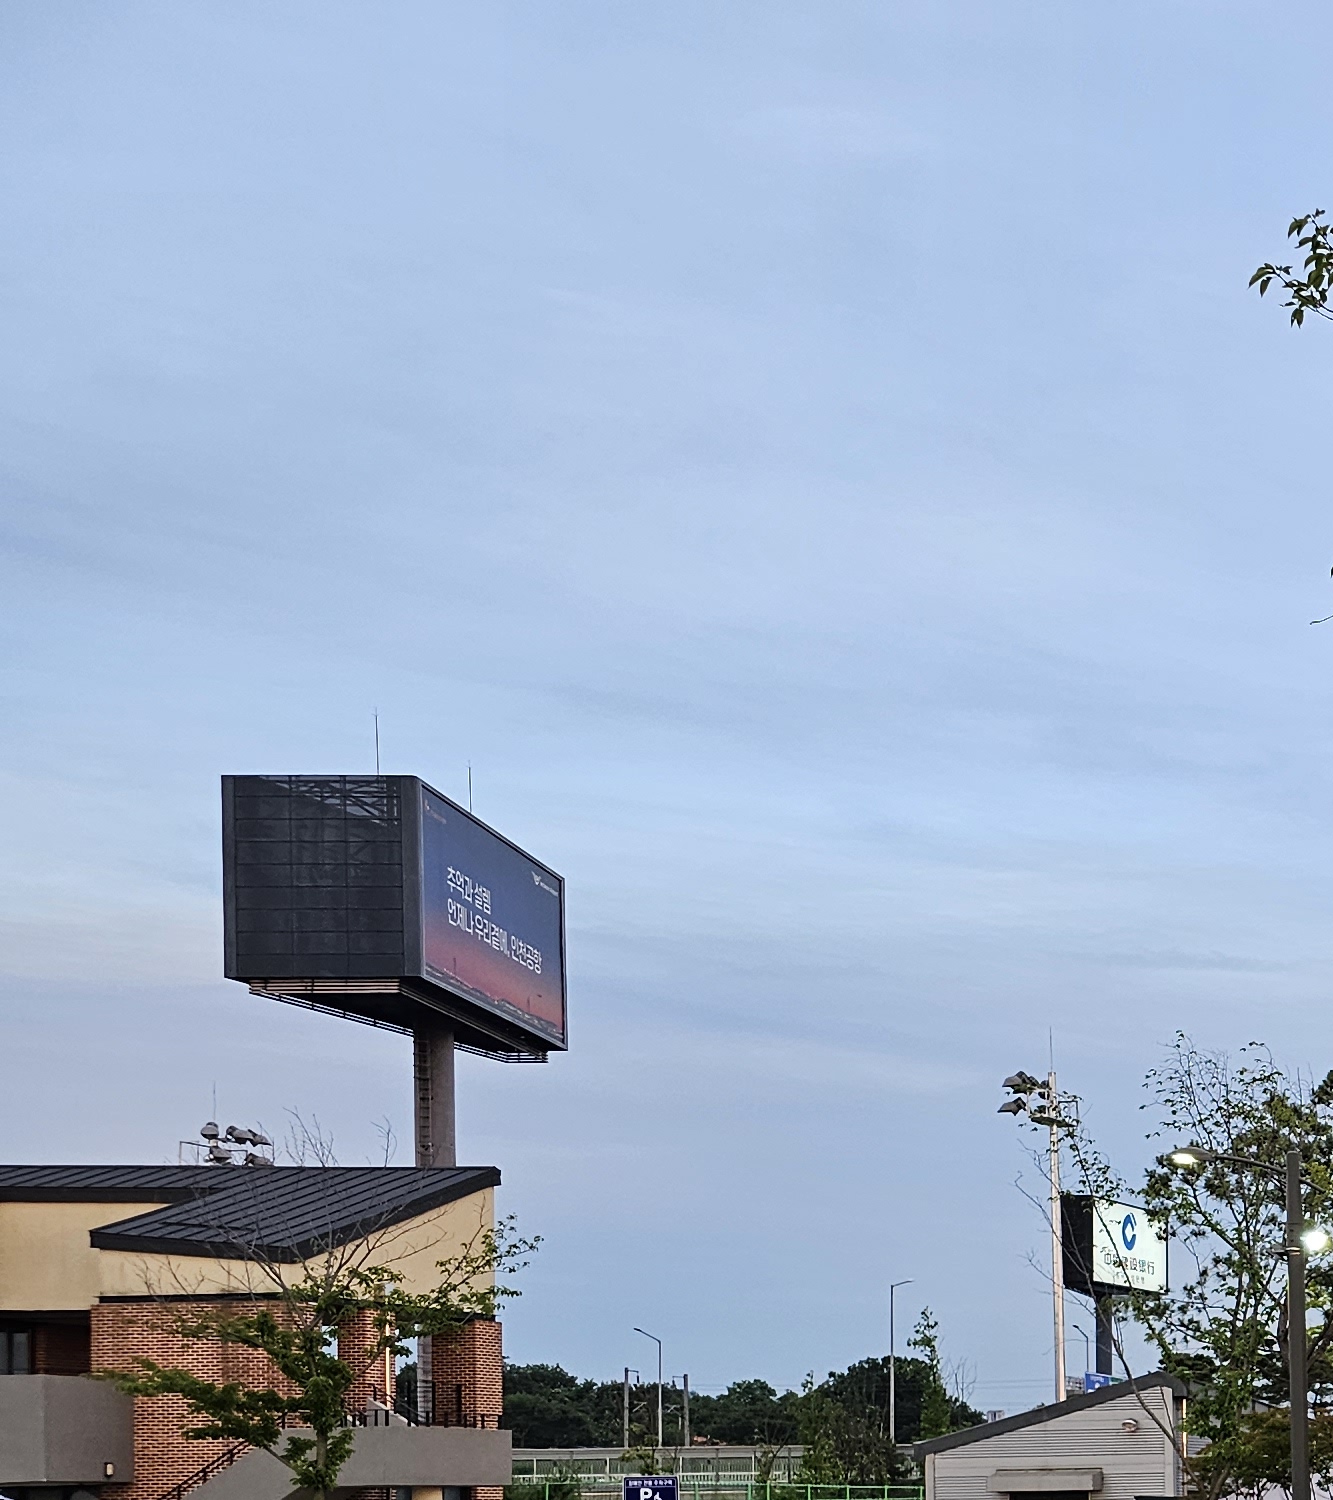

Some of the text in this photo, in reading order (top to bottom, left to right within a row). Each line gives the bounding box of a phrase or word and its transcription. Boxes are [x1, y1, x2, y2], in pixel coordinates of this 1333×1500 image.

[447, 866, 491, 914] 추억과 설렘
[448, 898, 474, 935] 언제나
[511, 936, 542, 974] 인천공항
